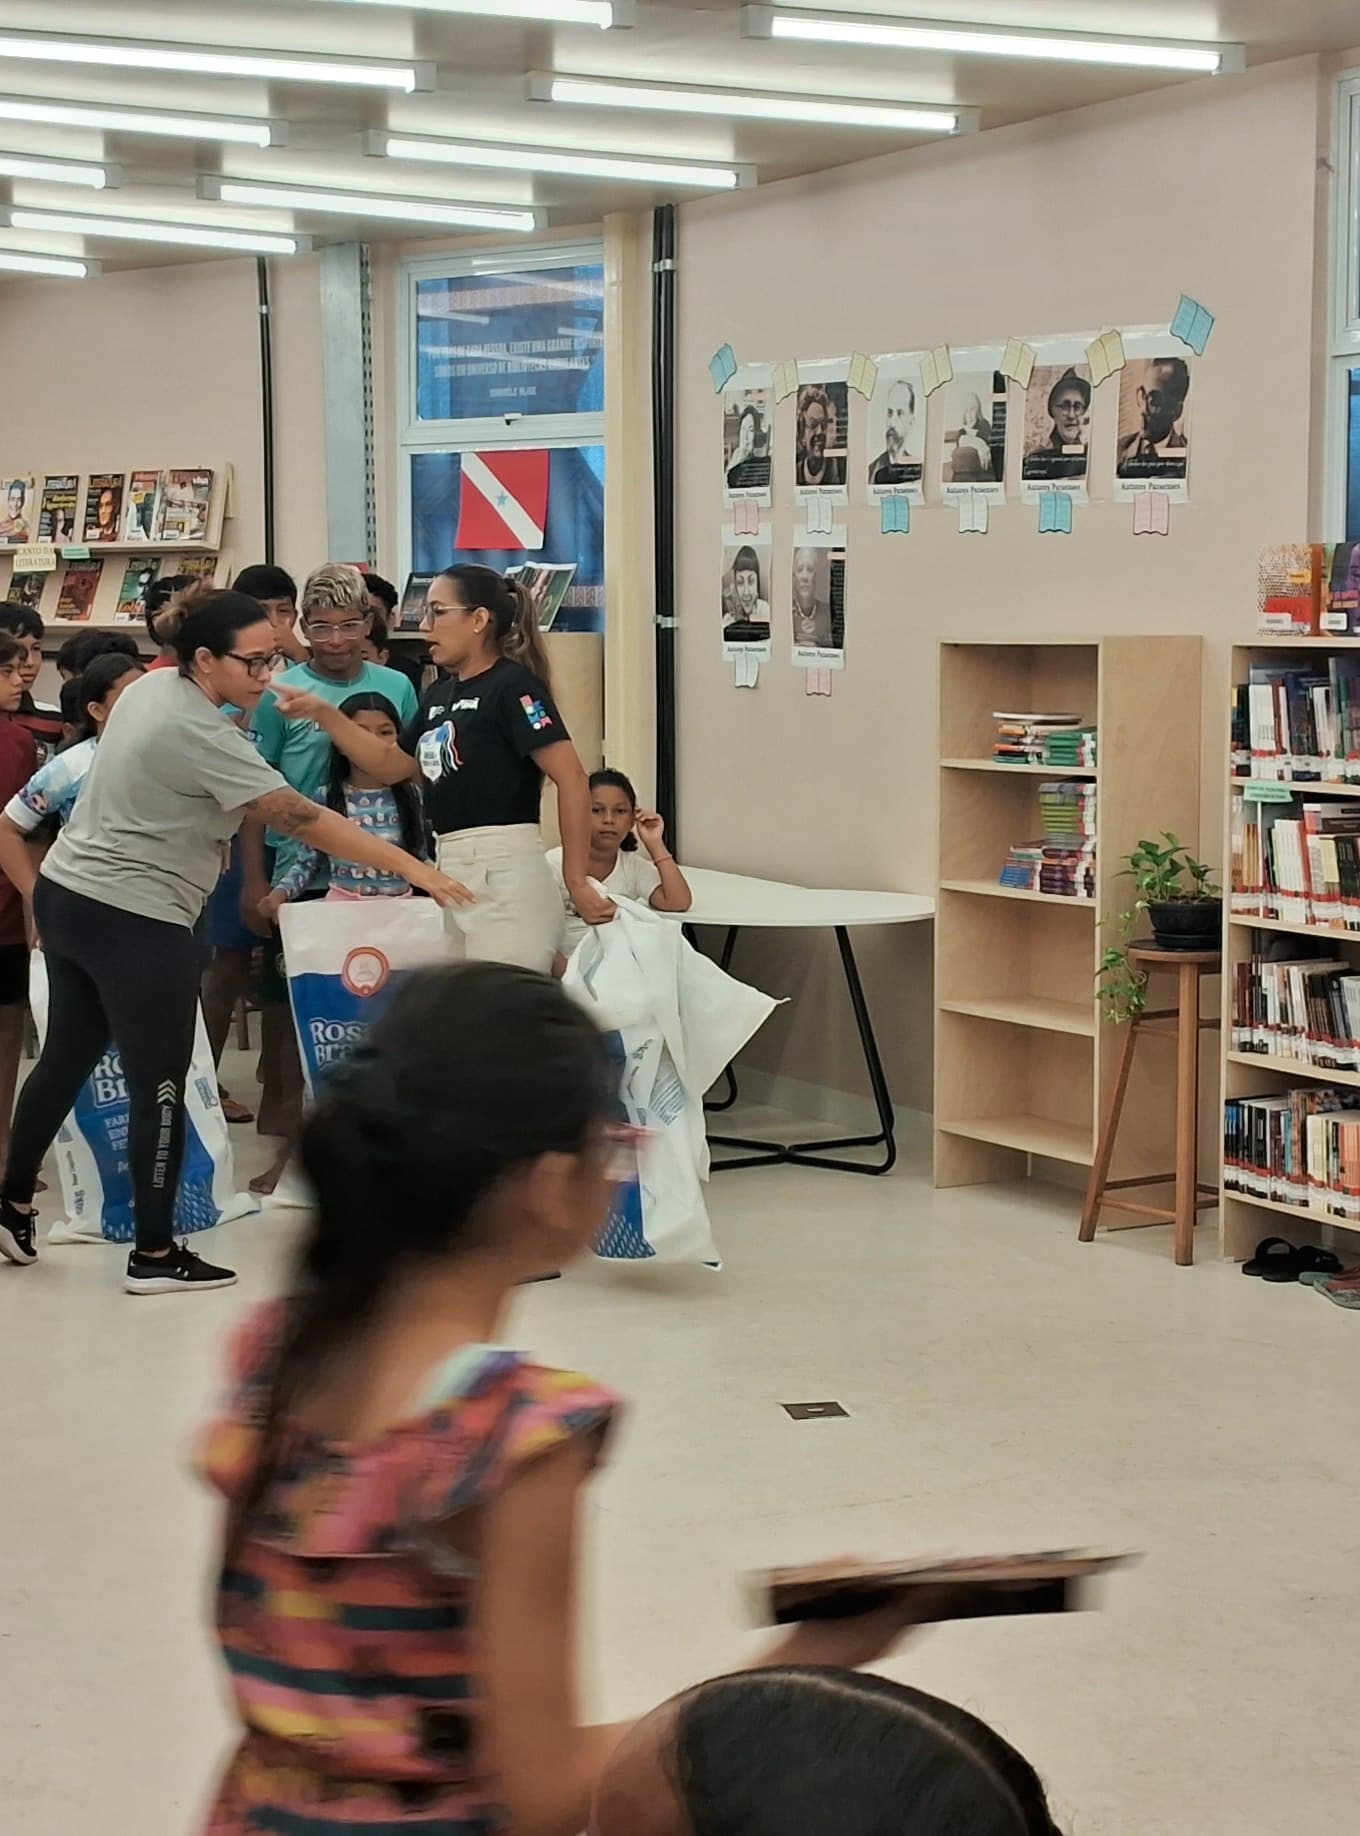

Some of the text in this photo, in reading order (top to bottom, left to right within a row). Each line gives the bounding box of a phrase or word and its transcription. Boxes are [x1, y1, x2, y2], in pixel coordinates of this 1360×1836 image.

[161, 1105, 173, 1126] BODY
[158, 1126, 172, 1149] YOUR
[155, 1149, 169, 1161] TO
